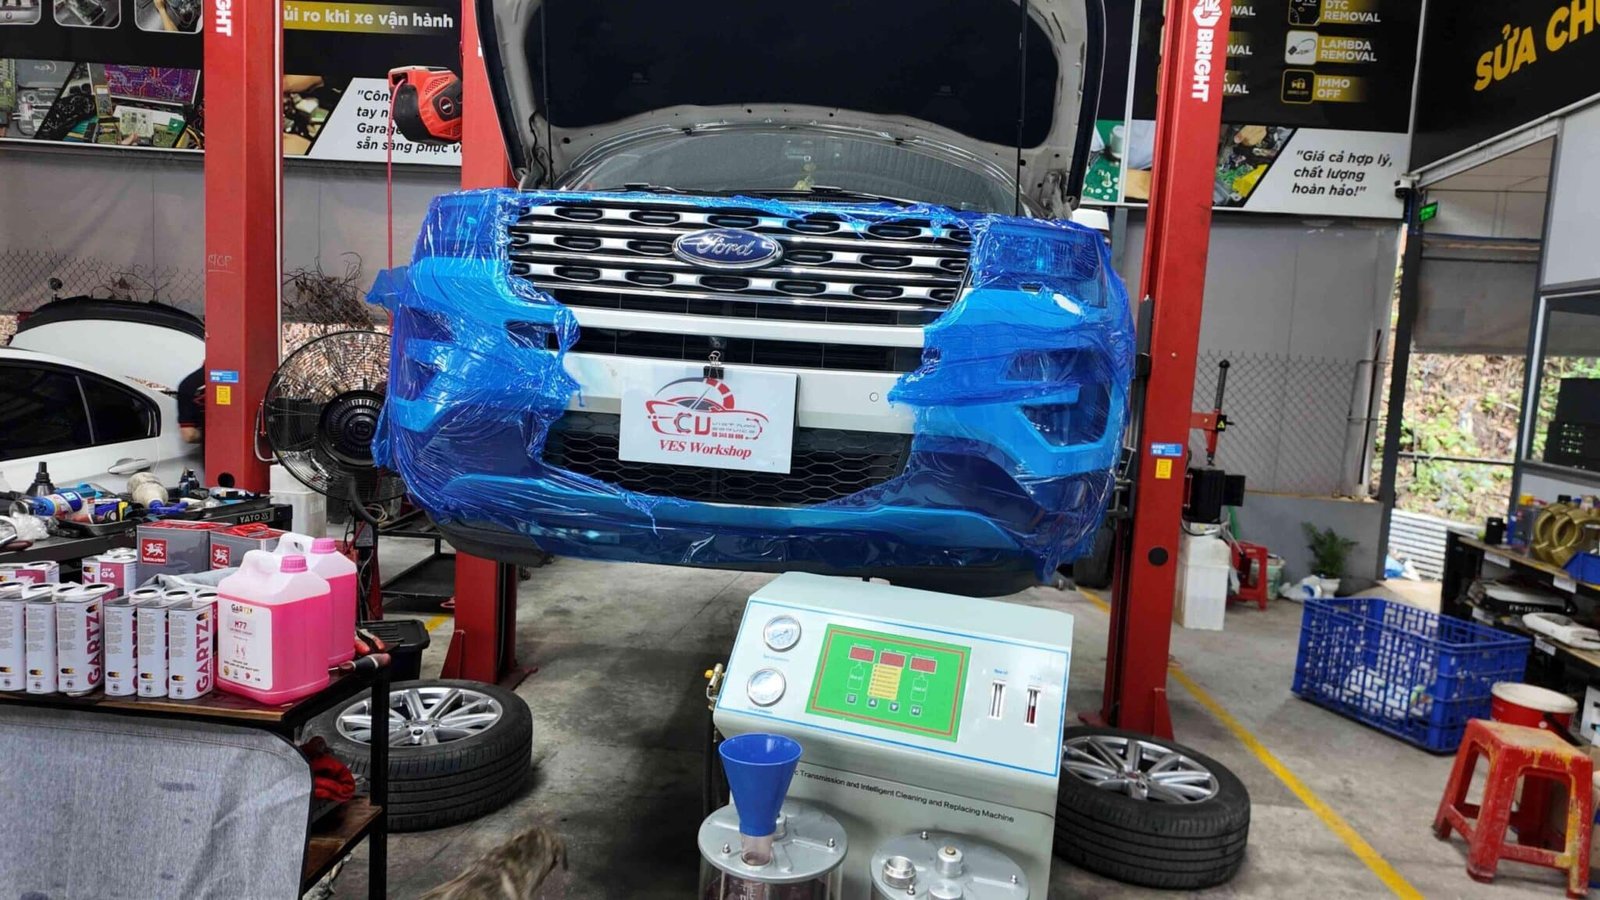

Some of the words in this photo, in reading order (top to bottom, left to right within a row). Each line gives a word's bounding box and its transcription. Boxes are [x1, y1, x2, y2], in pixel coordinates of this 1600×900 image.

[1325, 0, 1348, 9] DTC
[303, 12, 320, 22] ro
[325, 10, 349, 23] khi
[354, 14, 374, 24] xe
[378, 11, 408, 29] vận
[412, 13, 453, 28] hành
[1324, 11, 1381, 22] REMOVAL
[1321, 40, 1372, 50] LAMBDA
[1320, 50, 1377, 61] REMOVAL
[1474, 24, 1537, 91] SỬA
[1191, 28, 1214, 102] BRIGHT
[1318, 79, 1350, 88] IMMO
[357, 90, 391, 104] "Côn
[1317, 89, 1341, 98] OFF
[356, 106, 377, 119] tay
[1296, 150, 1325, 162] "Giá
[1328, 150, 1344, 163] cả
[1347, 152, 1374, 166] hợp
[1293, 165, 1323, 178] chất
[1326, 168, 1365, 182] lượng
[1291, 182, 1325, 195] hoàn
[1328, 183, 1367, 197] hảo!"
[695, 233, 756, 257] Ford
[659, 440, 687, 453] VES
[690, 442, 752, 461] Workshop
[240, 514, 261, 524] YATO
[86, 612, 101, 685] GARTZ
[195, 620, 210, 693] GARTZ
[800, 769, 846, 787] Transmission
[846, 780, 861, 790] and
[860, 783, 895, 798] Intelligent
[895, 790, 928, 805] Cleaning
[928, 799, 943, 808] and
[943, 801, 981, 817] Replacing
[981, 809, 1015, 823] Machine
